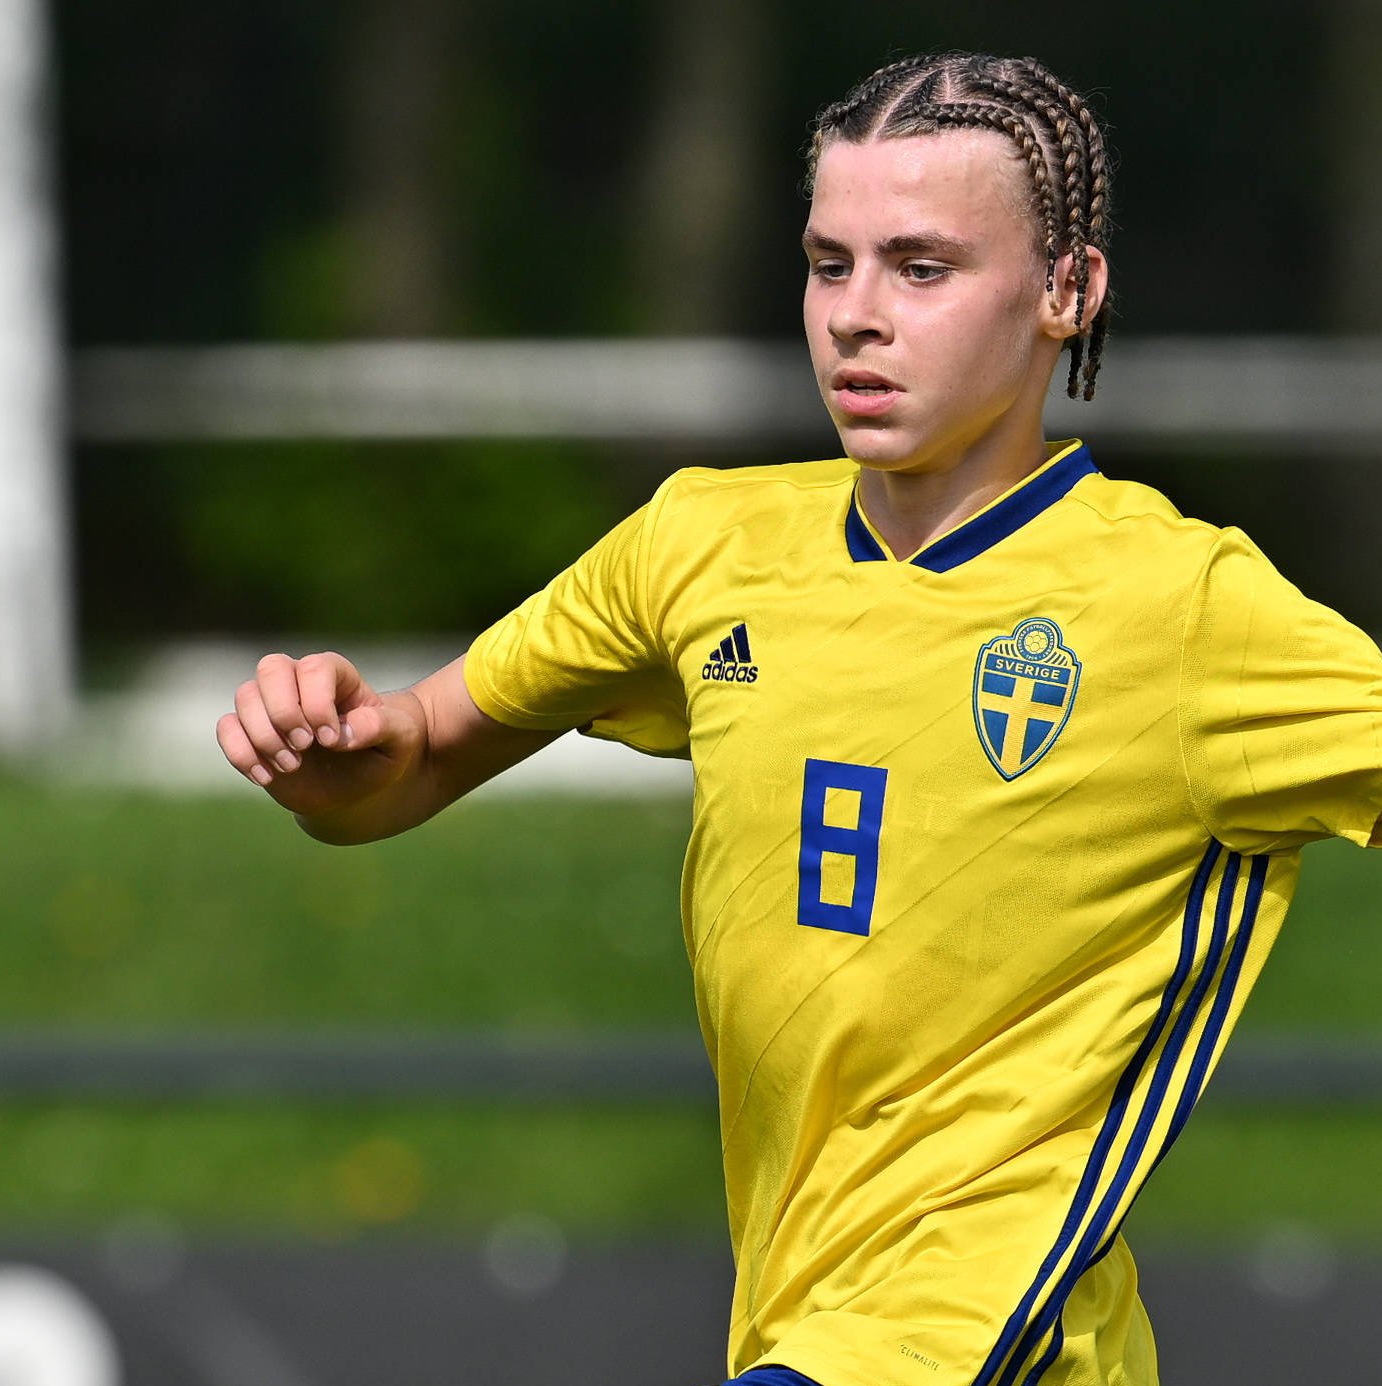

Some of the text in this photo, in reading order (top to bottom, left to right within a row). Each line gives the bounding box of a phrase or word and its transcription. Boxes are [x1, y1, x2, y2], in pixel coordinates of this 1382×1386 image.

[701, 660, 759, 684] adidas
[995, 658, 1062, 681] SVERIGE
[797, 757, 889, 938] 8
